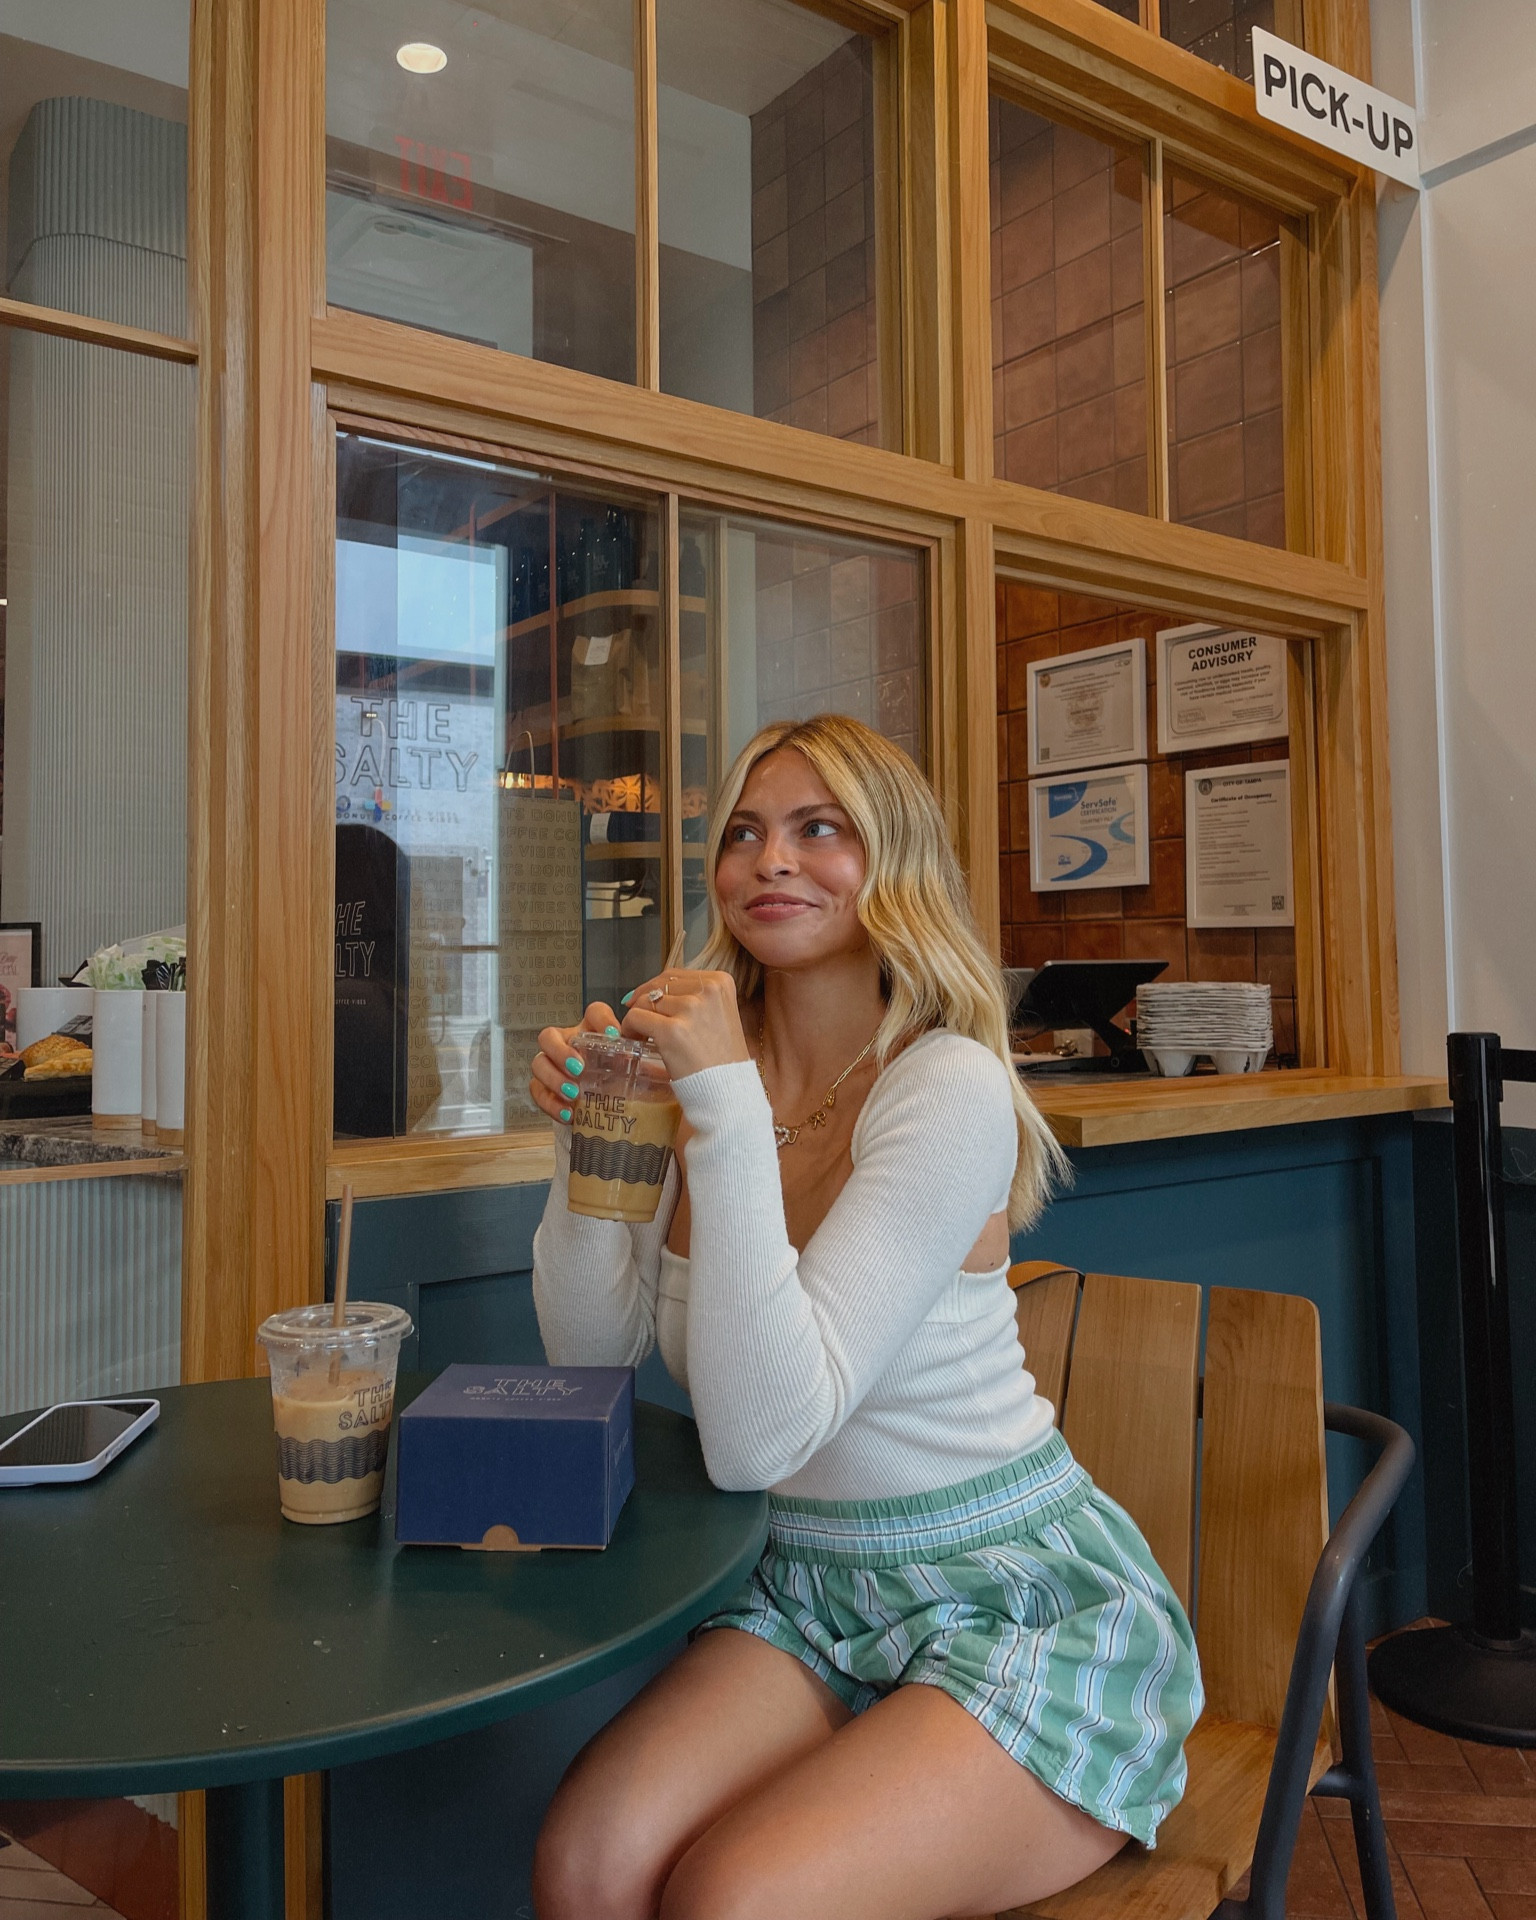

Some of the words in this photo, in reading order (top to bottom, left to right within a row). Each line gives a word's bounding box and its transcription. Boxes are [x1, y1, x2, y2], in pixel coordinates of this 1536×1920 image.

[1263, 53, 1414, 158] PICK-UP
[1188, 636, 1258, 660] CONSUMER
[1191, 650, 1254, 672] ADVISORY
[350, 696, 451, 743] THE
[335, 812, 374, 820] DONUT
[1080, 797, 1117, 810] ServSafe
[584, 1091, 626, 1114] THE
[575, 1108, 637, 1134] SALTY
[353, 1379, 393, 1408] THE
[338, 1399, 393, 1431] SALT
